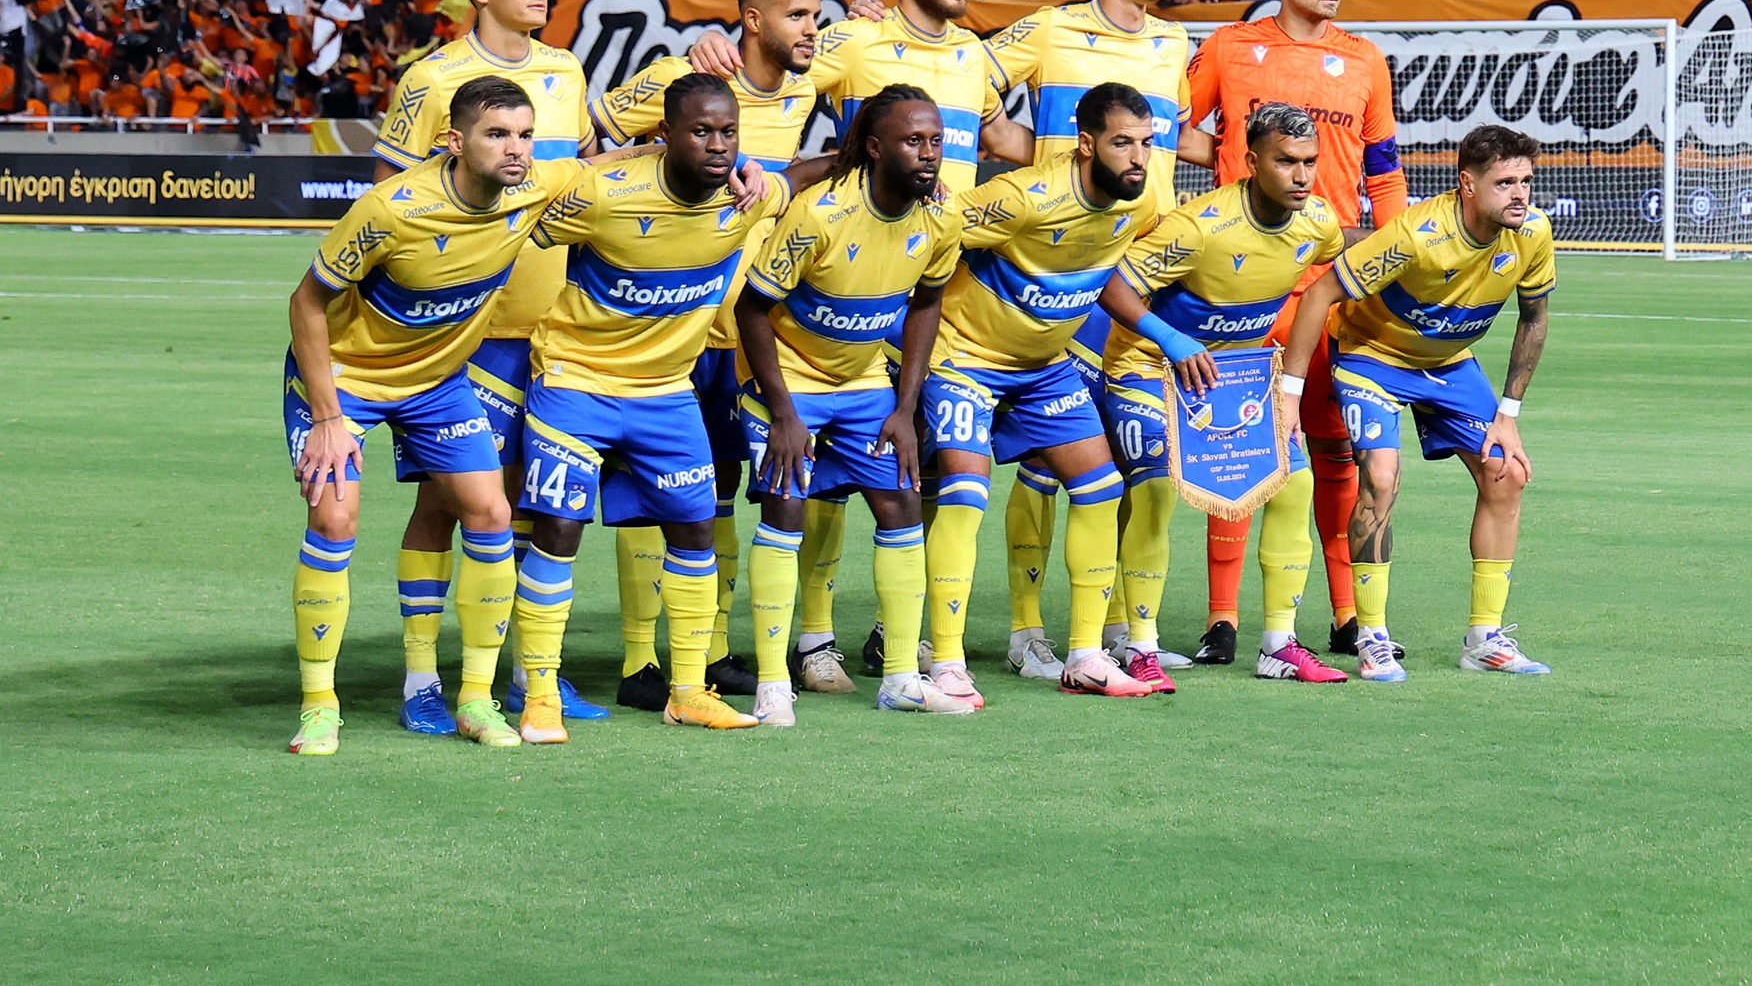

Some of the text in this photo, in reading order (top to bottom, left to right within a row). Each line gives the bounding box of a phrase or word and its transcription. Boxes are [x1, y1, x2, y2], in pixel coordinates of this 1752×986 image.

[69, 168, 156, 204] έγκριση
[161, 170, 256, 200] δανείου!
[607, 182, 652, 199] Osteocare
[403, 201, 446, 219] Osteocare
[1036, 192, 1072, 213] Osteocare
[1210, 214, 1244, 235] Osteocare
[609, 274, 725, 306] Stoiximan
[935, 399, 975, 443] 29
[1236, 429, 1248, 439] FC
[1116, 419, 1143, 461] 10
[538, 441, 596, 475] cablenet
[1201, 452, 1228, 462] Slovan
[1231, 446, 1271, 459] Bratislava
[525, 458, 568, 509] 44
